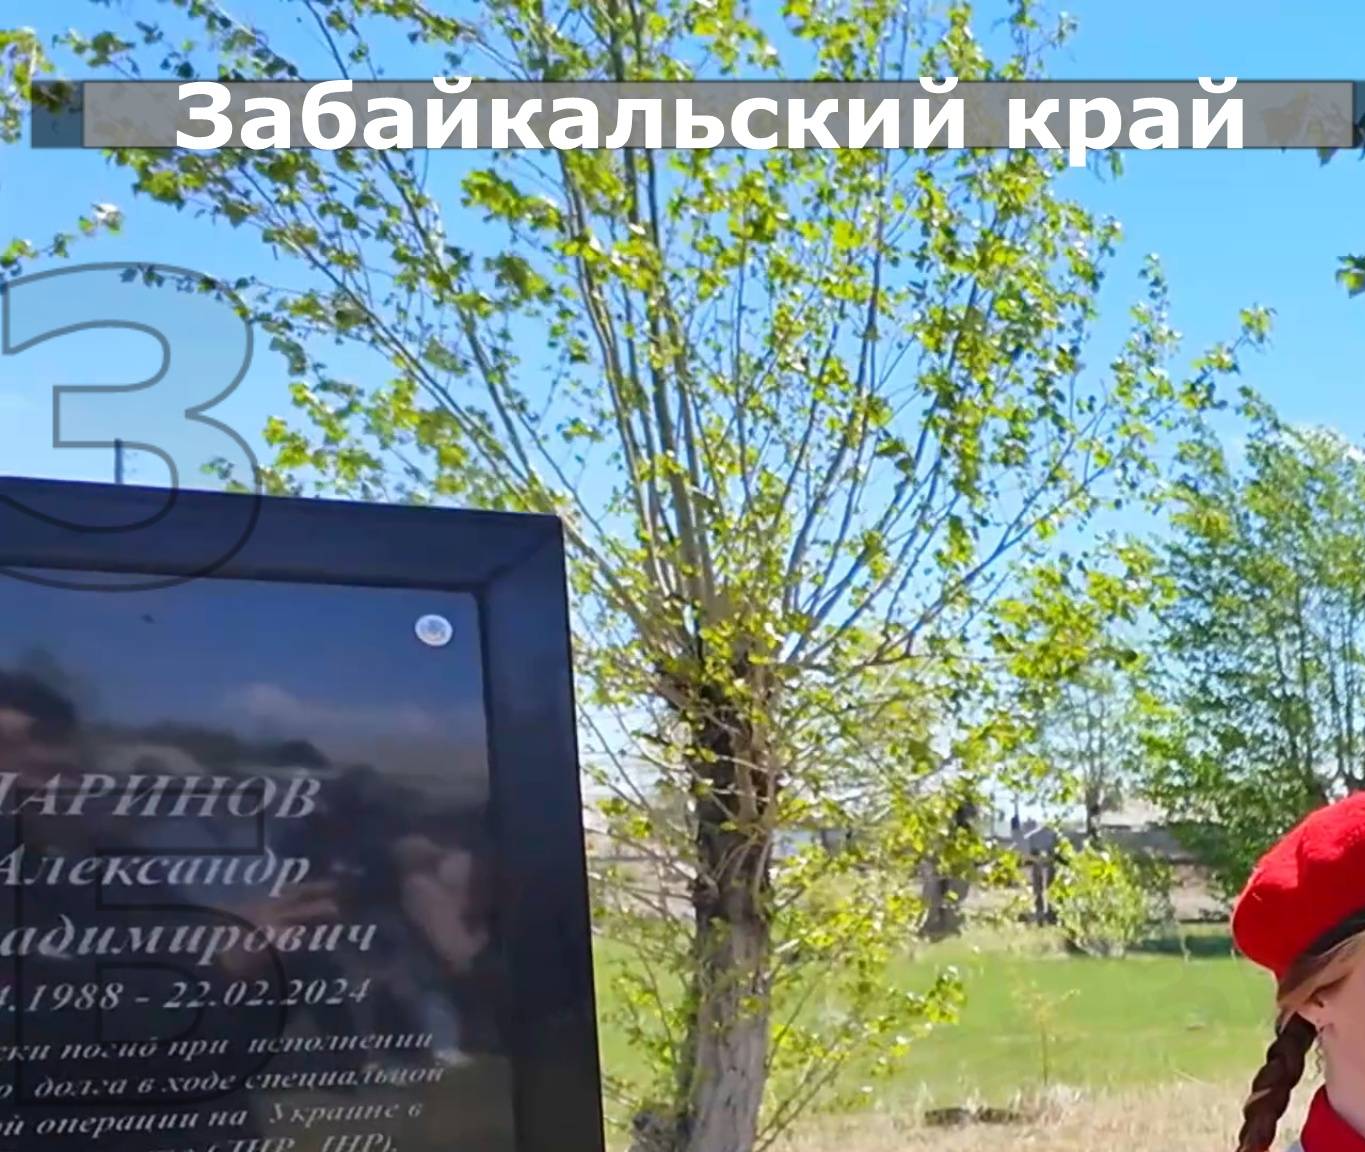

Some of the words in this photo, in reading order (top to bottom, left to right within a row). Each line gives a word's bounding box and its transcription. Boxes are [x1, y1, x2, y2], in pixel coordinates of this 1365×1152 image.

[0, 912, 378, 967] адимирович
[162, 976, 373, 1009] 22.02.2024
[168, 1038, 230, 1064] при
[247, 1031, 433, 1056] исполнении
[34, 1071, 128, 1098] долга
[137, 1079, 155, 1094] в
[162, 1071, 236, 1093] ходе
[245, 1064, 446, 1091] специальной
[36, 1113, 199, 1139] операции
[208, 1109, 249, 1127] на
[269, 1102, 400, 1129] Украине
